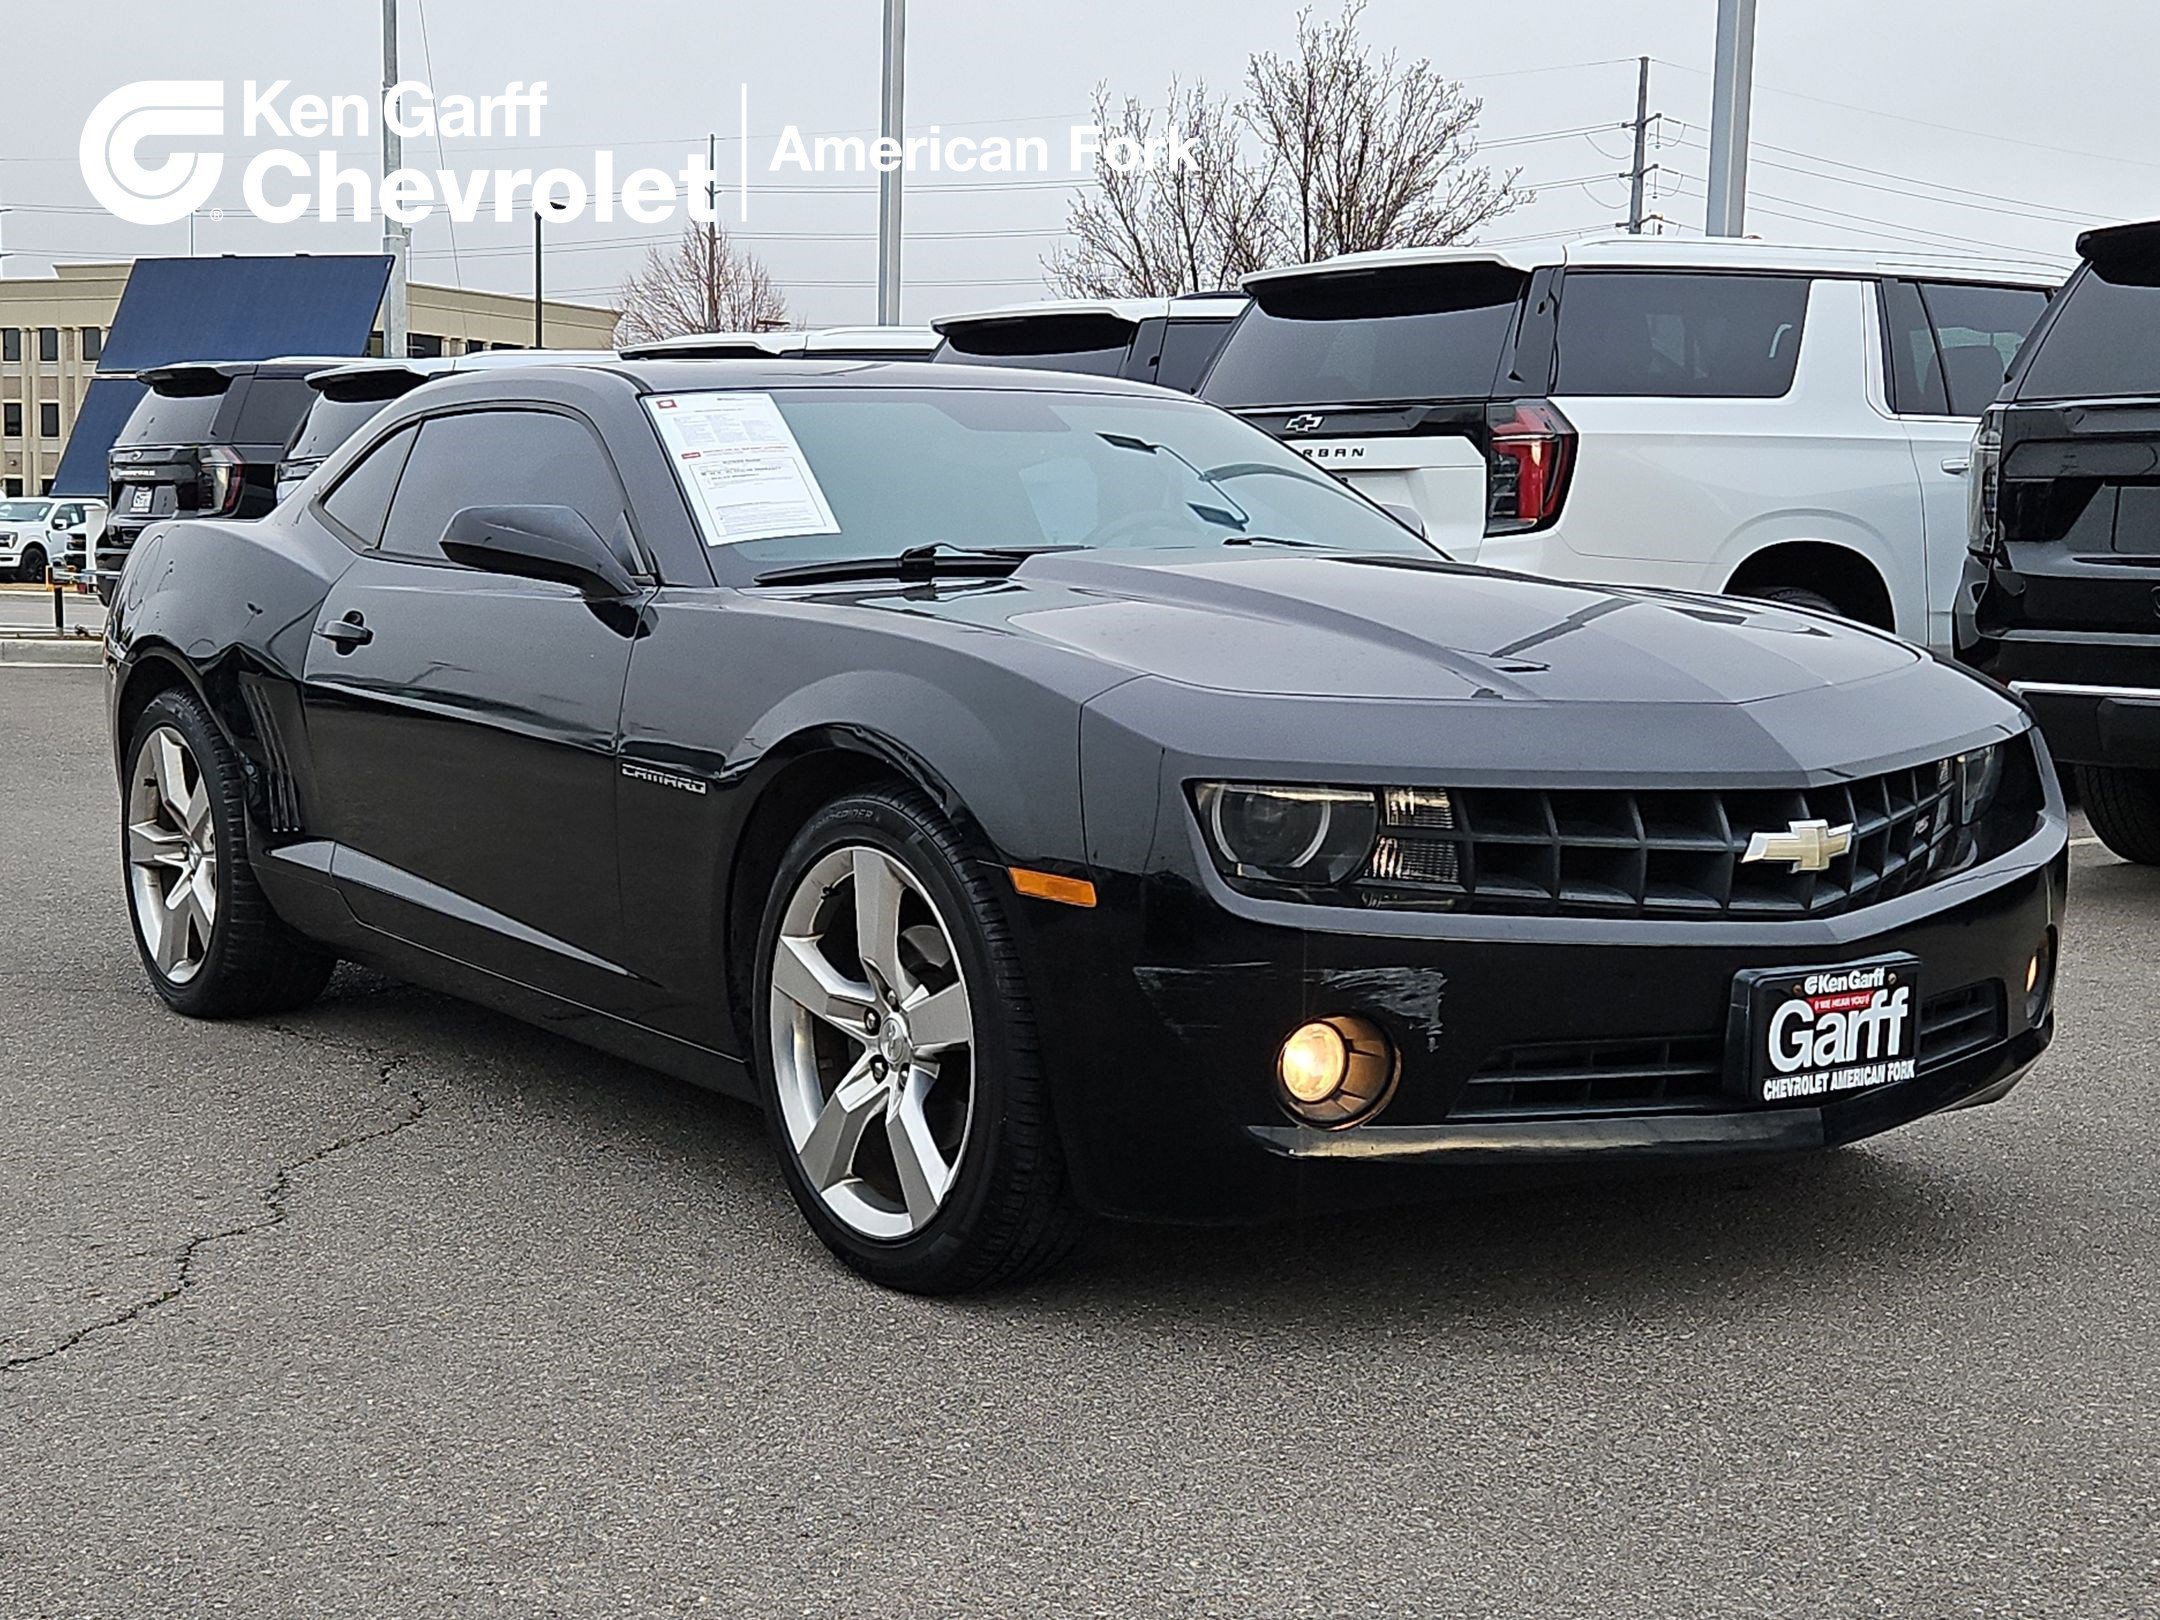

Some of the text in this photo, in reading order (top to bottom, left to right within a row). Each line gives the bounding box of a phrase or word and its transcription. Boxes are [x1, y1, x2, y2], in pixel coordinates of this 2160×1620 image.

[622, 763, 706, 795] CAMARO
[1818, 973, 1848, 994] Ken
[1848, 967, 1885, 990] Garff
[1768, 986, 1909, 1073] Garff
[1763, 1059, 1916, 1101] CHEVROLET AMERICAN FORK
